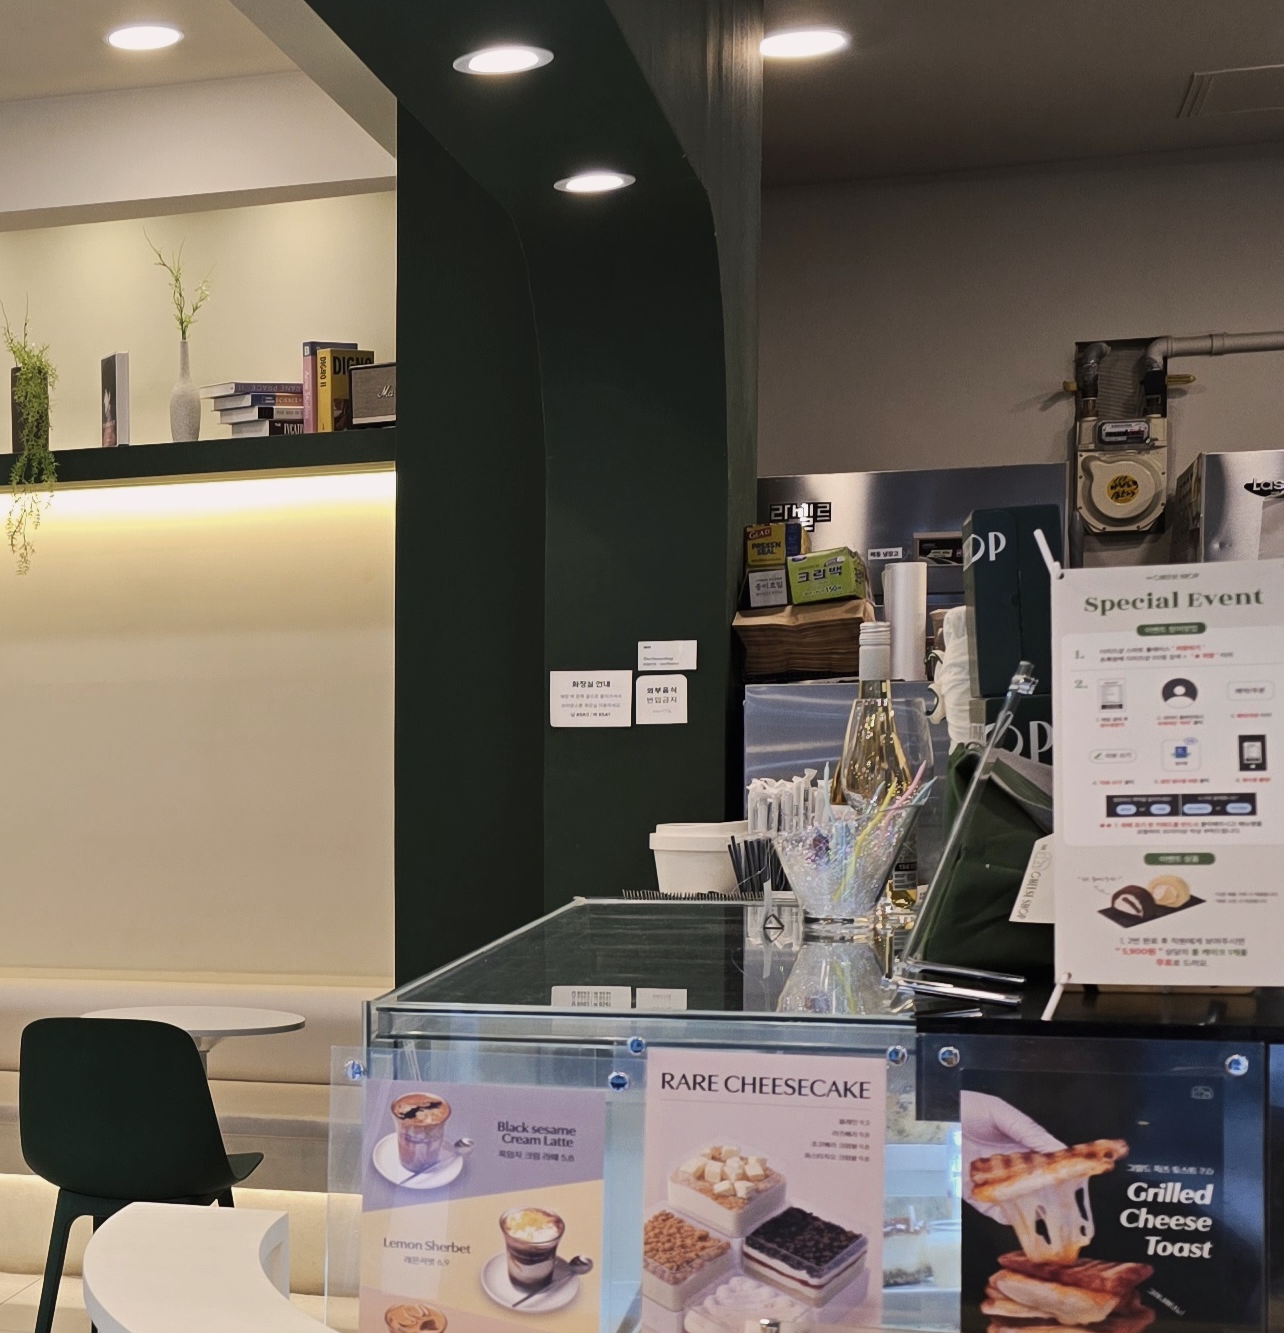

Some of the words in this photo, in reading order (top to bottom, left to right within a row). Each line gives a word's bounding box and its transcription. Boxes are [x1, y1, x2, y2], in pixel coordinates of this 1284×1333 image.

[749, 528, 771, 539] GLAD
[1084, 591, 1179, 616] Special
[1187, 588, 1264, 609] Event
[661, 1072, 719, 1092] RARE
[724, 1075, 872, 1099] CHEESECAKE
[497, 1120, 529, 1133] Black
[531, 1125, 577, 1136] sesame
[501, 1133, 541, 1146] Cream
[543, 1135, 574, 1148] Latte
[1127, 1182, 1214, 1205] Grilled
[1120, 1208, 1213, 1231] Cheese
[383, 1237, 423, 1250] Lemon
[425, 1240, 471, 1254] Sherbet
[1145, 1236, 1213, 1258] Toast
